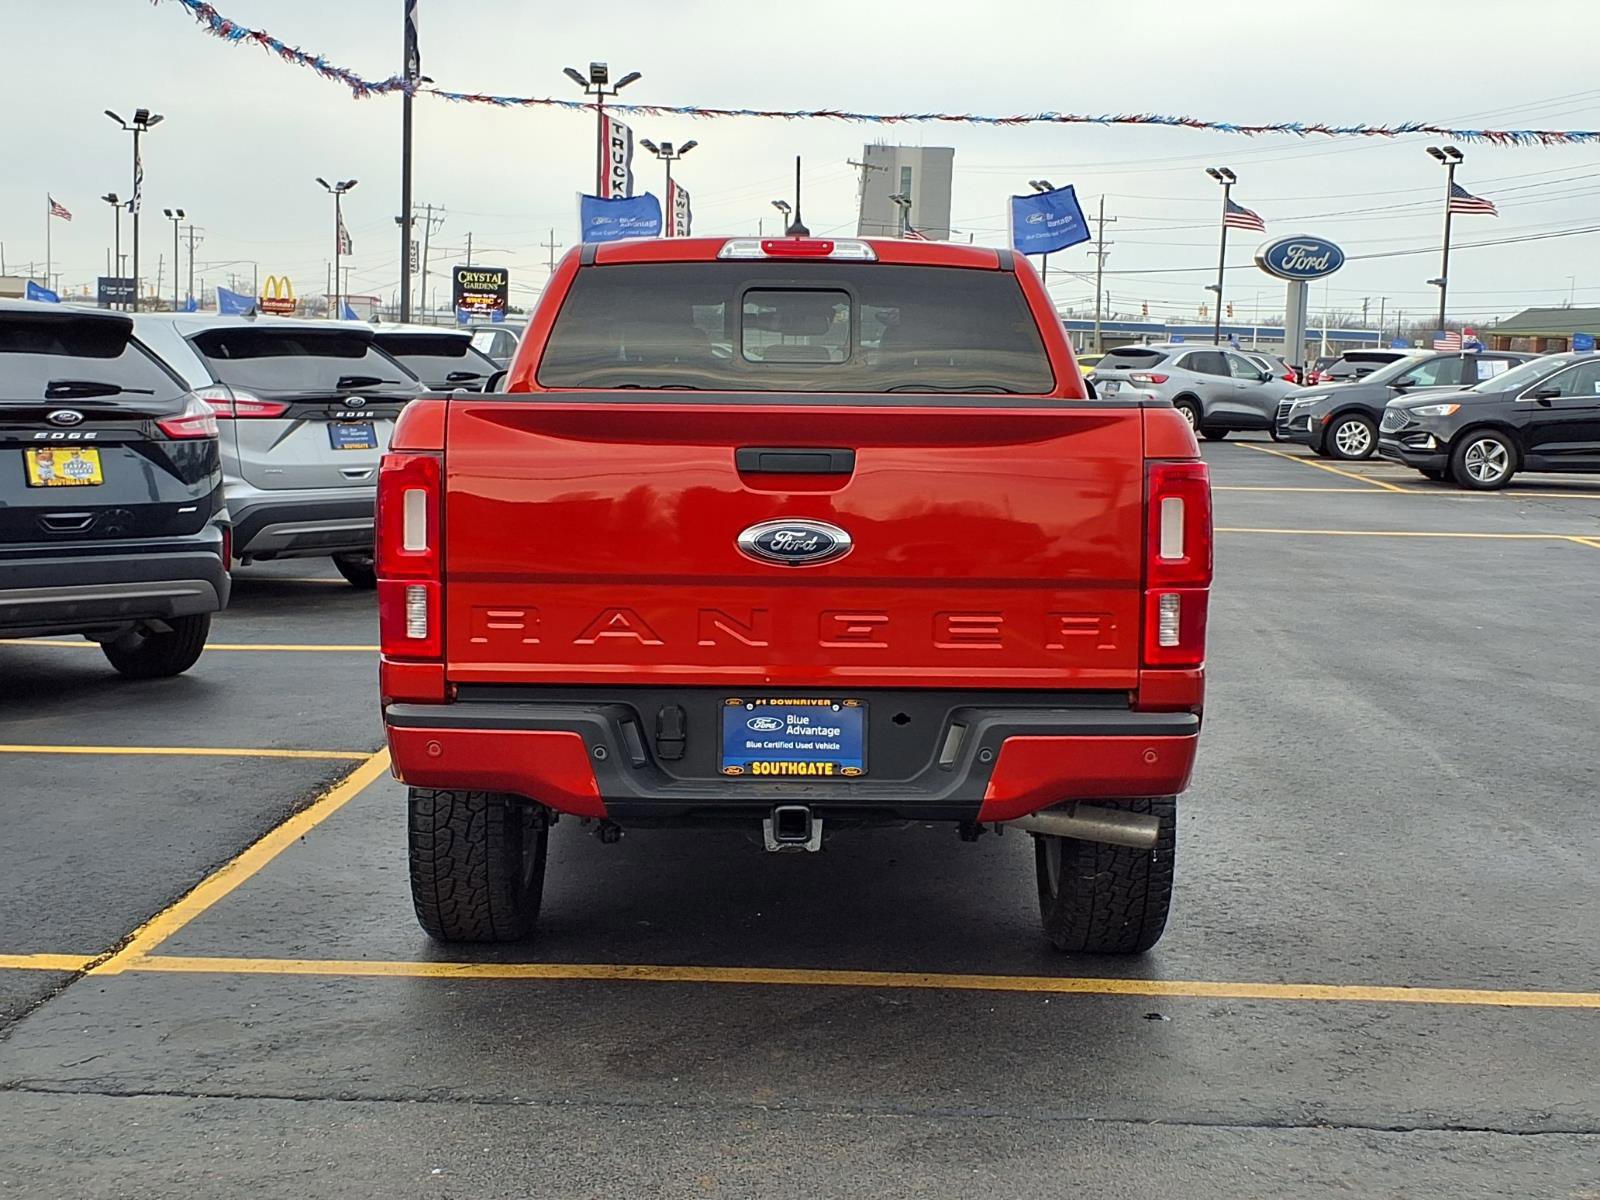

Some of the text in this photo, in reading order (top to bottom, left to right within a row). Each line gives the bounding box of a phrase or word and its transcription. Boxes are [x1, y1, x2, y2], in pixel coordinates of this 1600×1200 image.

[1282, 244, 1330, 271] Ford
[457, 271, 506, 285] CRYSTAL
[463, 281, 499, 290] GARDENS
[769, 530, 818, 552] Ford
[470, 605, 1117, 649] RANGER
[770, 698, 831, 706] DOWNRIVER
[753, 714, 810, 729] Ford Blue
[786, 726, 841, 738] Advantage
[763, 741, 793, 749] Certified
[815, 742, 840, 750] Vehicle
[752, 761, 833, 775] SOUTHGATE
